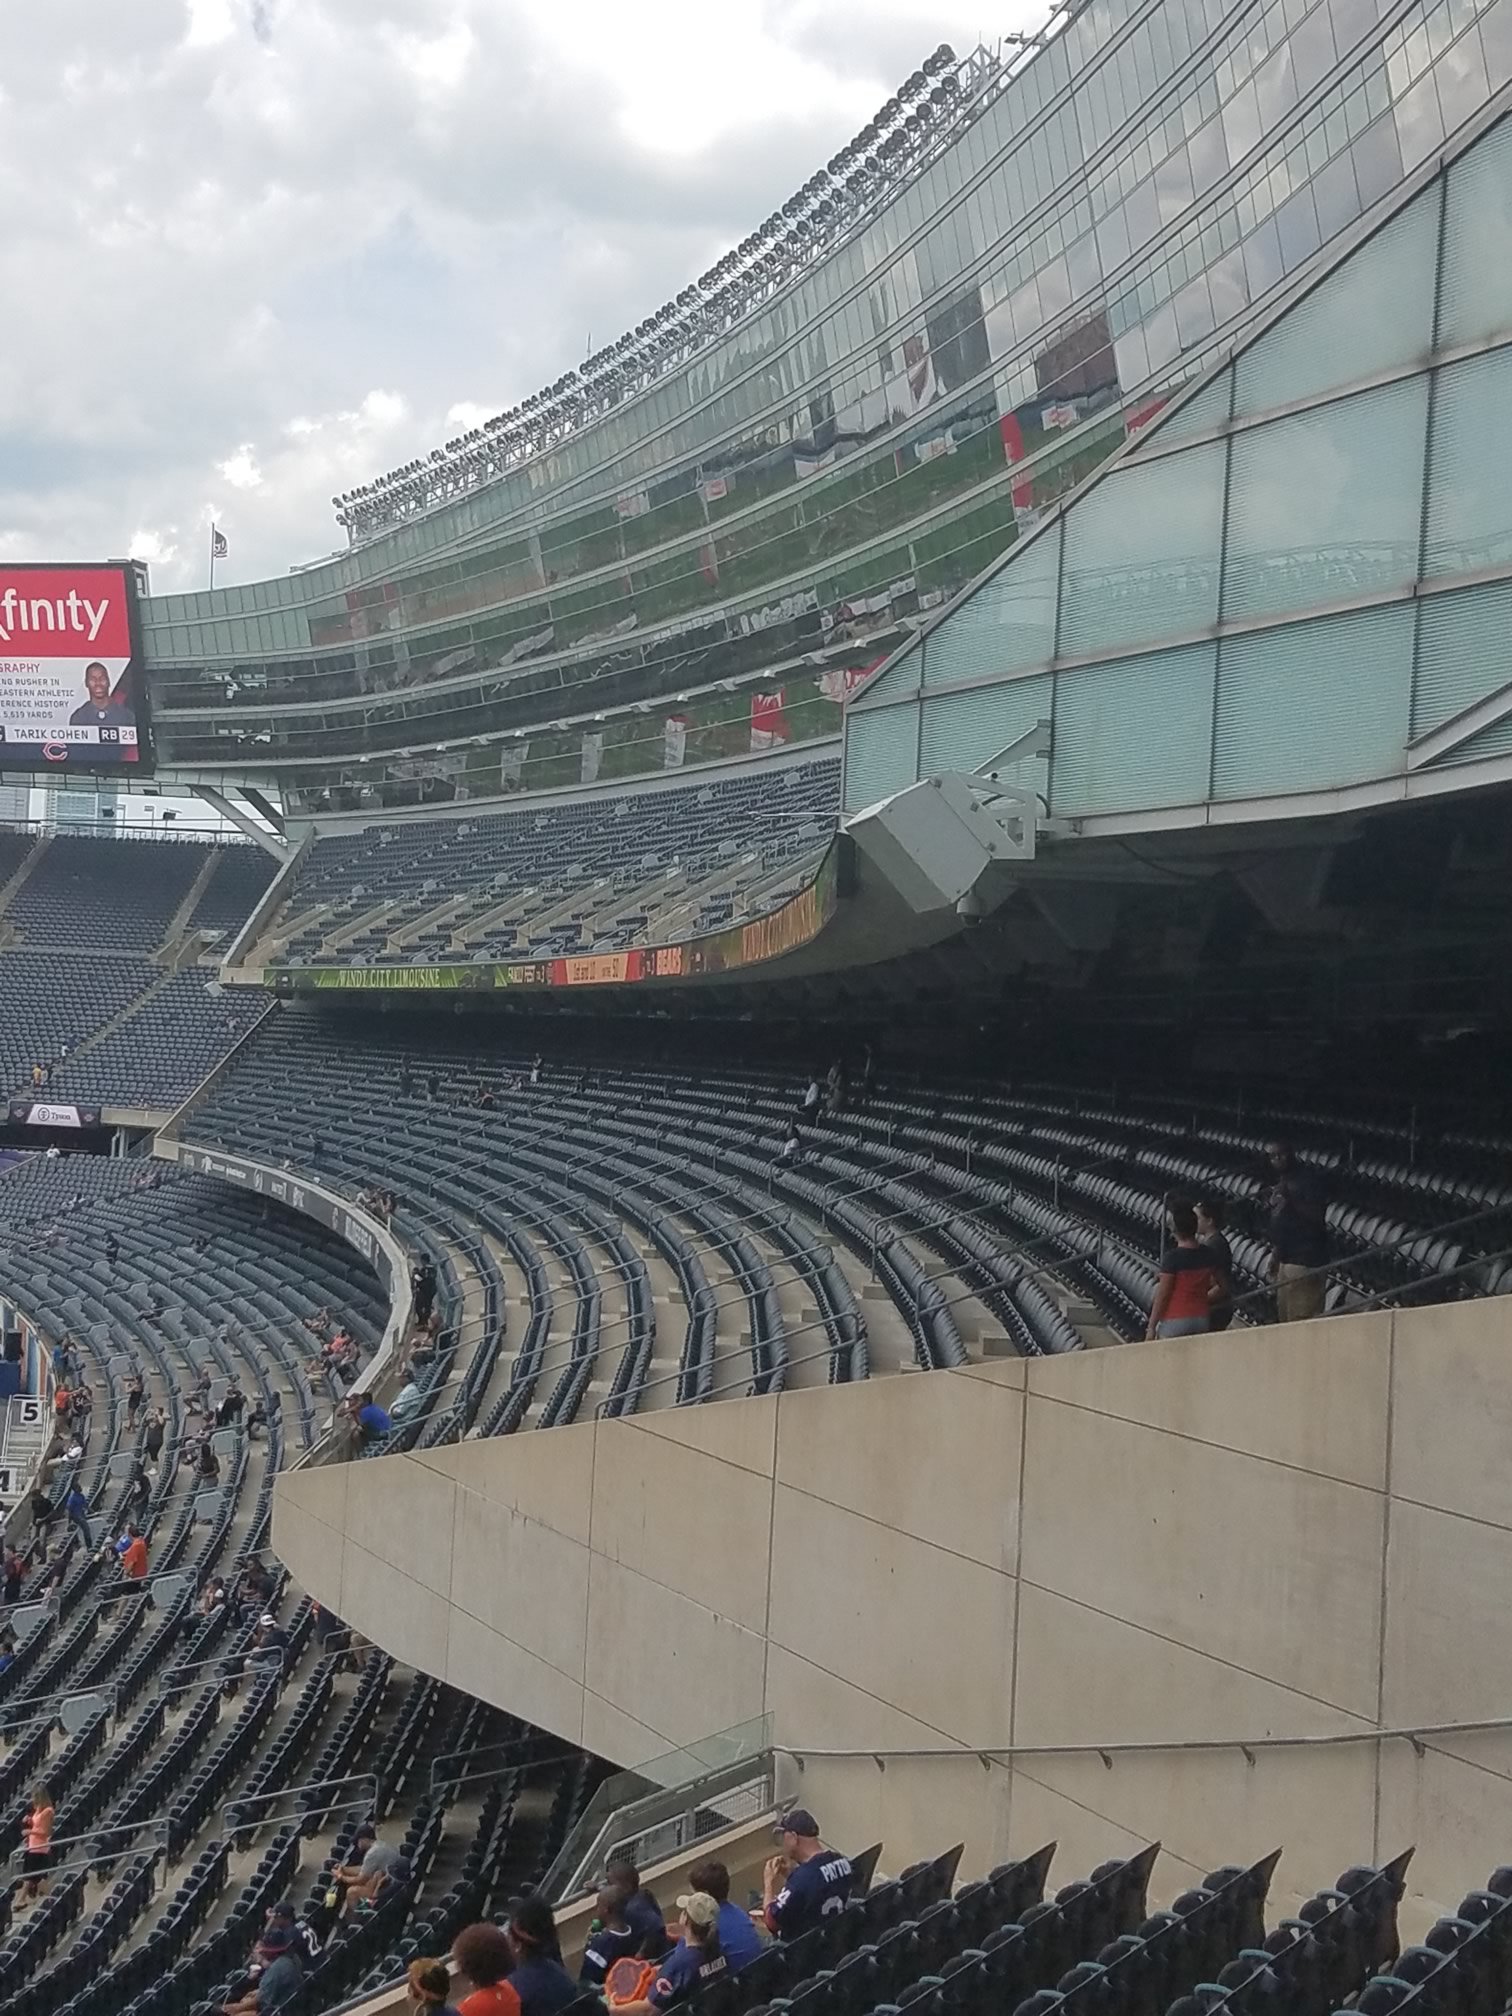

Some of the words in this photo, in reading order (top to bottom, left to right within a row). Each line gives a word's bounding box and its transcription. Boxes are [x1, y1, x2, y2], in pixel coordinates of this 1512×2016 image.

[15, 678, 48, 686] RUSHER
[37, 689, 75, 697] ATHLETIC
[34, 700, 69, 708] HISTORY
[26, 711, 53, 719] YARDS
[14, 729, 48, 739] TARIK
[50, 729, 89, 740] COHEN
[101, 730, 117, 741] RB
[121, 730, 135, 740] 29
[339, 969, 369, 987] WINDY
[370, 969, 392, 987] CITY
[393, 968, 441, 988] LIMOUSINE
[23, 1402, 38, 1421] 5
